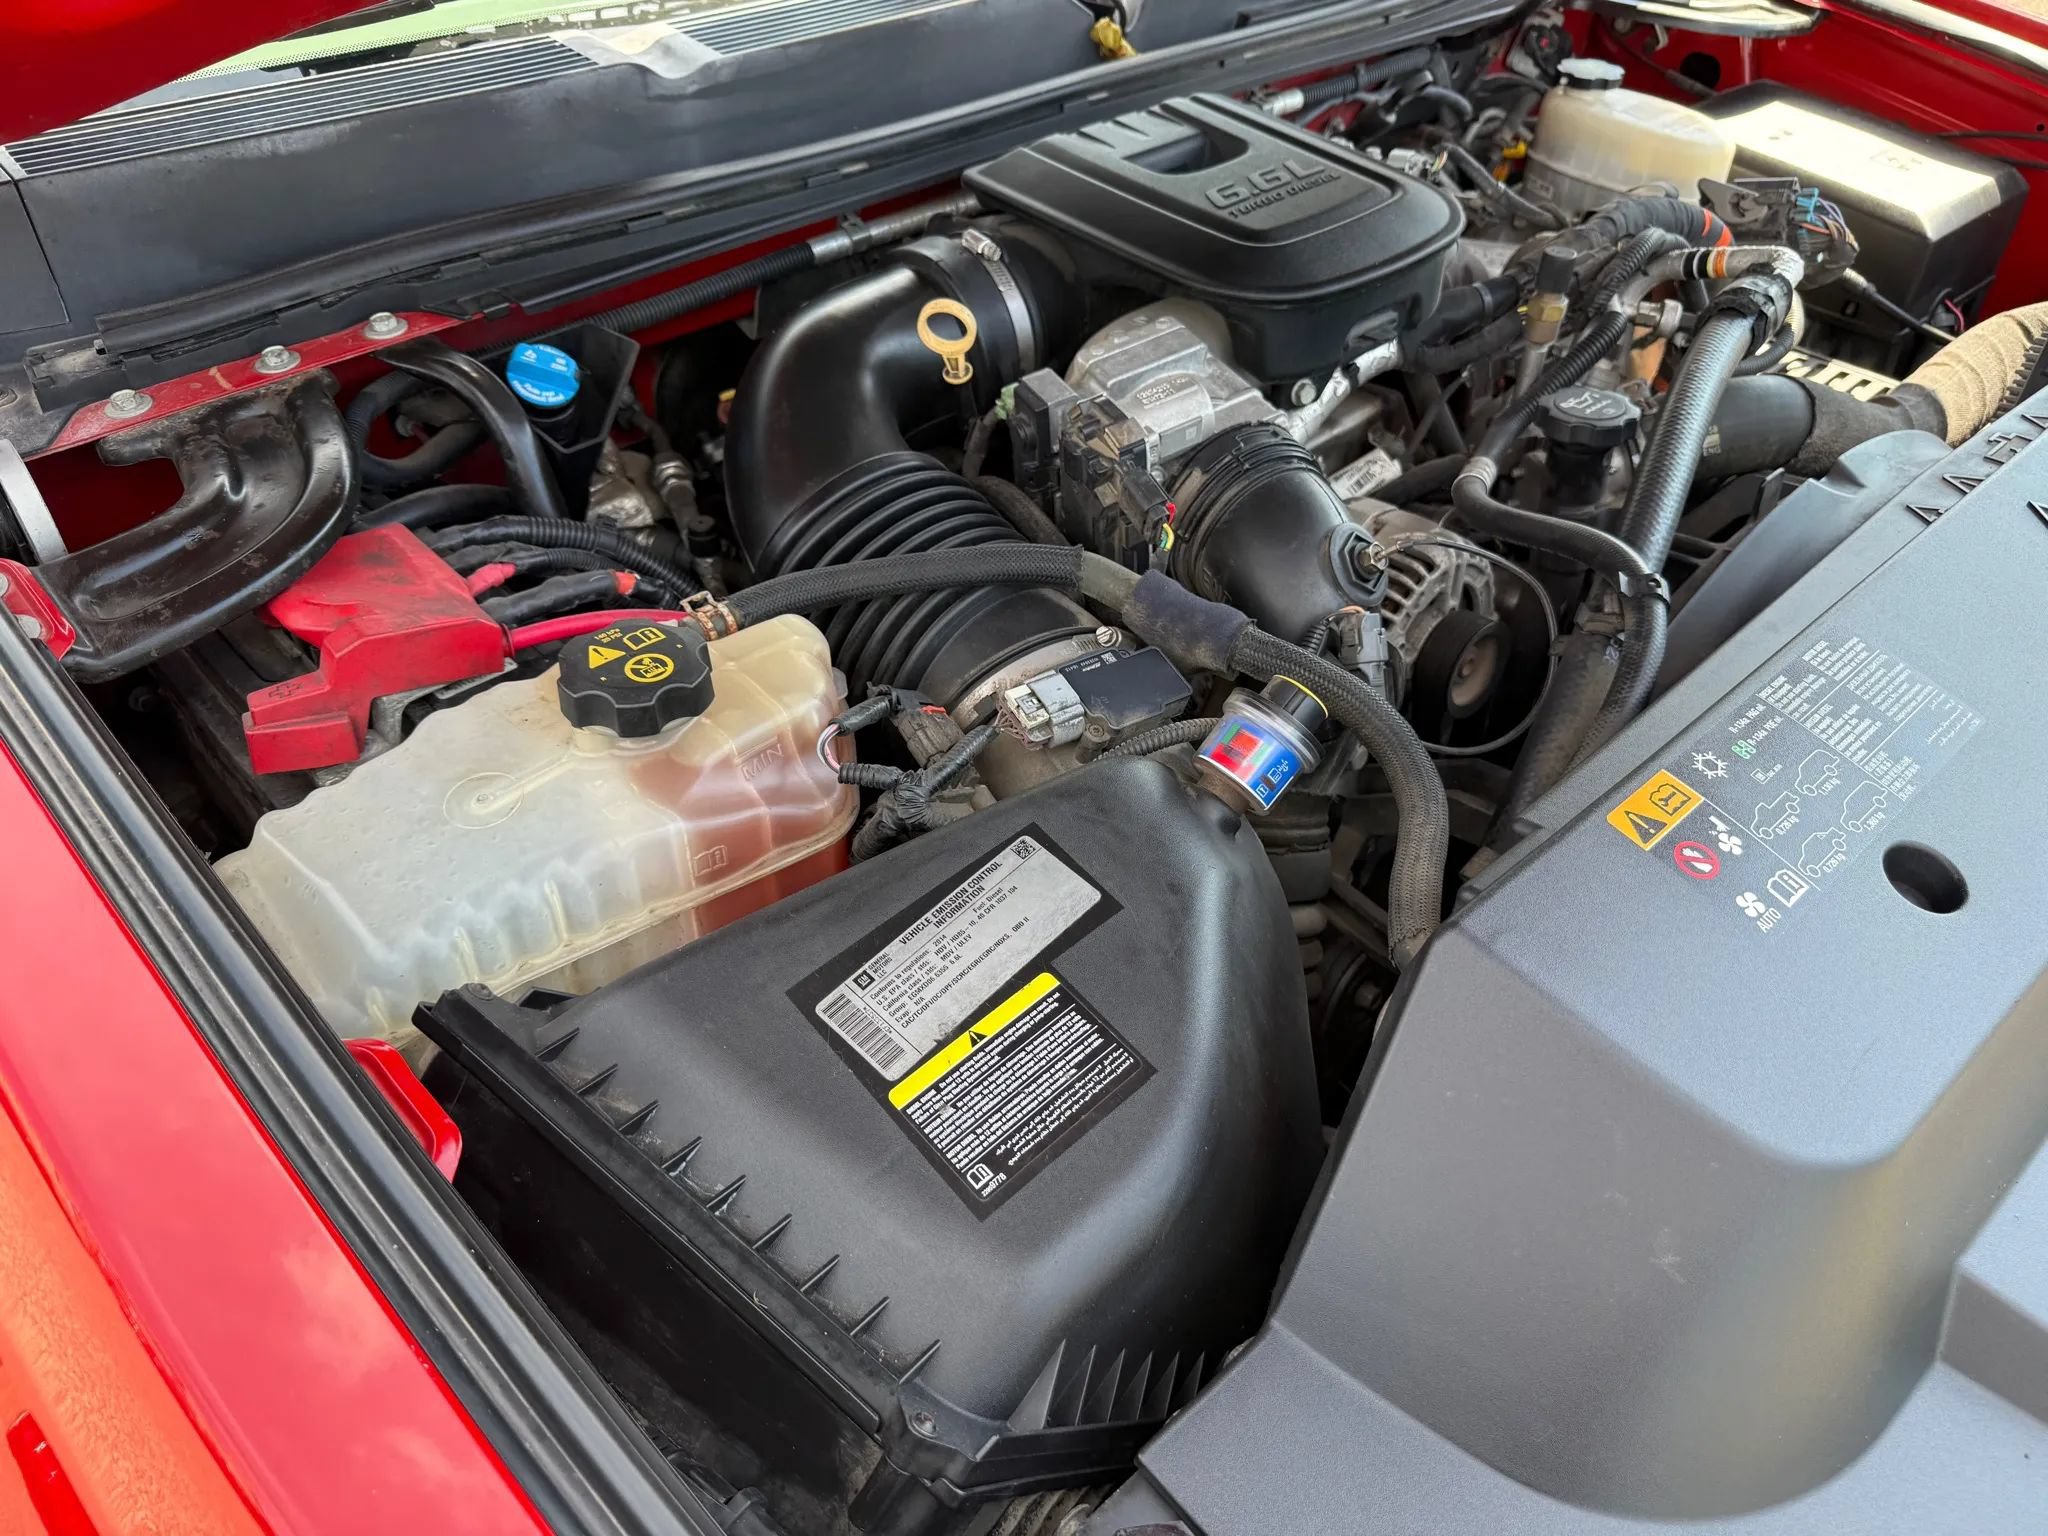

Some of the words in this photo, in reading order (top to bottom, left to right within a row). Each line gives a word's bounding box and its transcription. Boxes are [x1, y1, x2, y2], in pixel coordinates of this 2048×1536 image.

[1205, 157, 1326, 209] 6.6L
[1229, 191, 1285, 218] TURBO
[1286, 173, 1341, 197] DIESEL
[740, 743, 784, 782] MIN
[899, 916, 933, 945] VEHICLE
[930, 887, 969, 919] EMISSION
[966, 859, 1002, 889] CONTROL
[932, 884, 985, 929] INFORMATION
[1756, 908, 1781, 933] AUTO
[867, 951, 890, 970] GENERAL
[869, 977, 896, 1000] Conforms
[932, 934, 947, 946] 2014
[985, 886, 1003, 902] Diesel
[871, 956, 893, 974] MOTORS
[887, 983, 901, 995] EPA
[899, 971, 915, 985] class
[933, 943, 947, 956] HDV
[982, 902, 996, 914] CFR
[881, 988, 909, 1011] California
[906, 976, 922, 990] class
[939, 948, 955, 961] MDV
[955, 932, 973, 947] ULEV
[913, 995, 925, 1006] N/A
